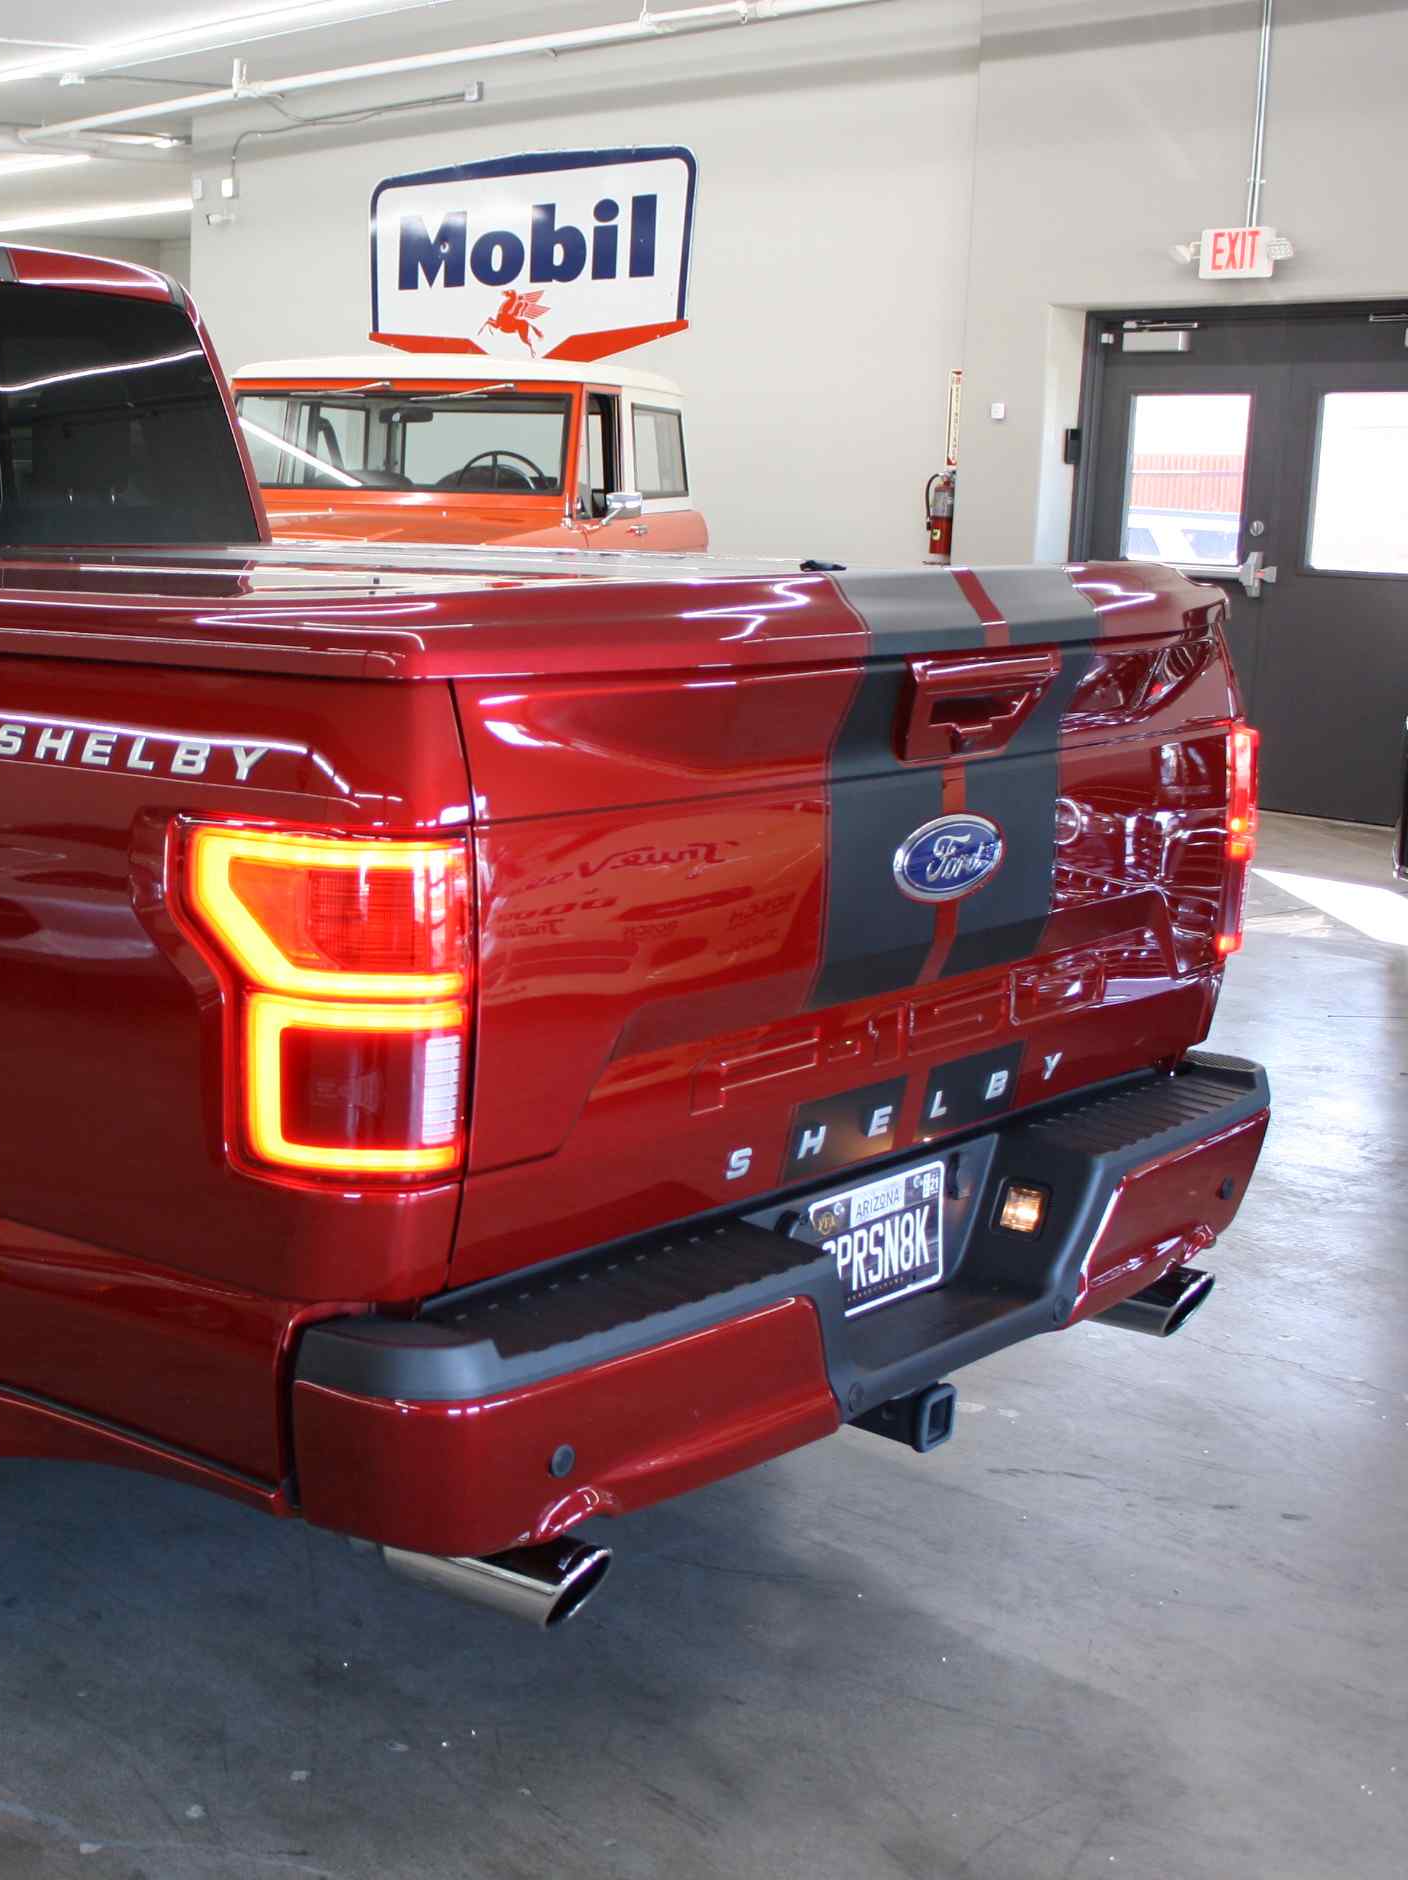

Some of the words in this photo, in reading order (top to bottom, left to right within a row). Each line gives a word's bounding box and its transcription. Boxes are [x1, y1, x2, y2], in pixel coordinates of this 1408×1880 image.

[398, 194, 657, 291] Mobil
[1212, 230, 1261, 270] EXIT
[926, 833, 992, 882] Ford
[725, 1052, 1062, 1180] SHELBY
[856, 1188, 901, 1218] ARIZONA
[822, 1205, 930, 1291] PRSN8K
